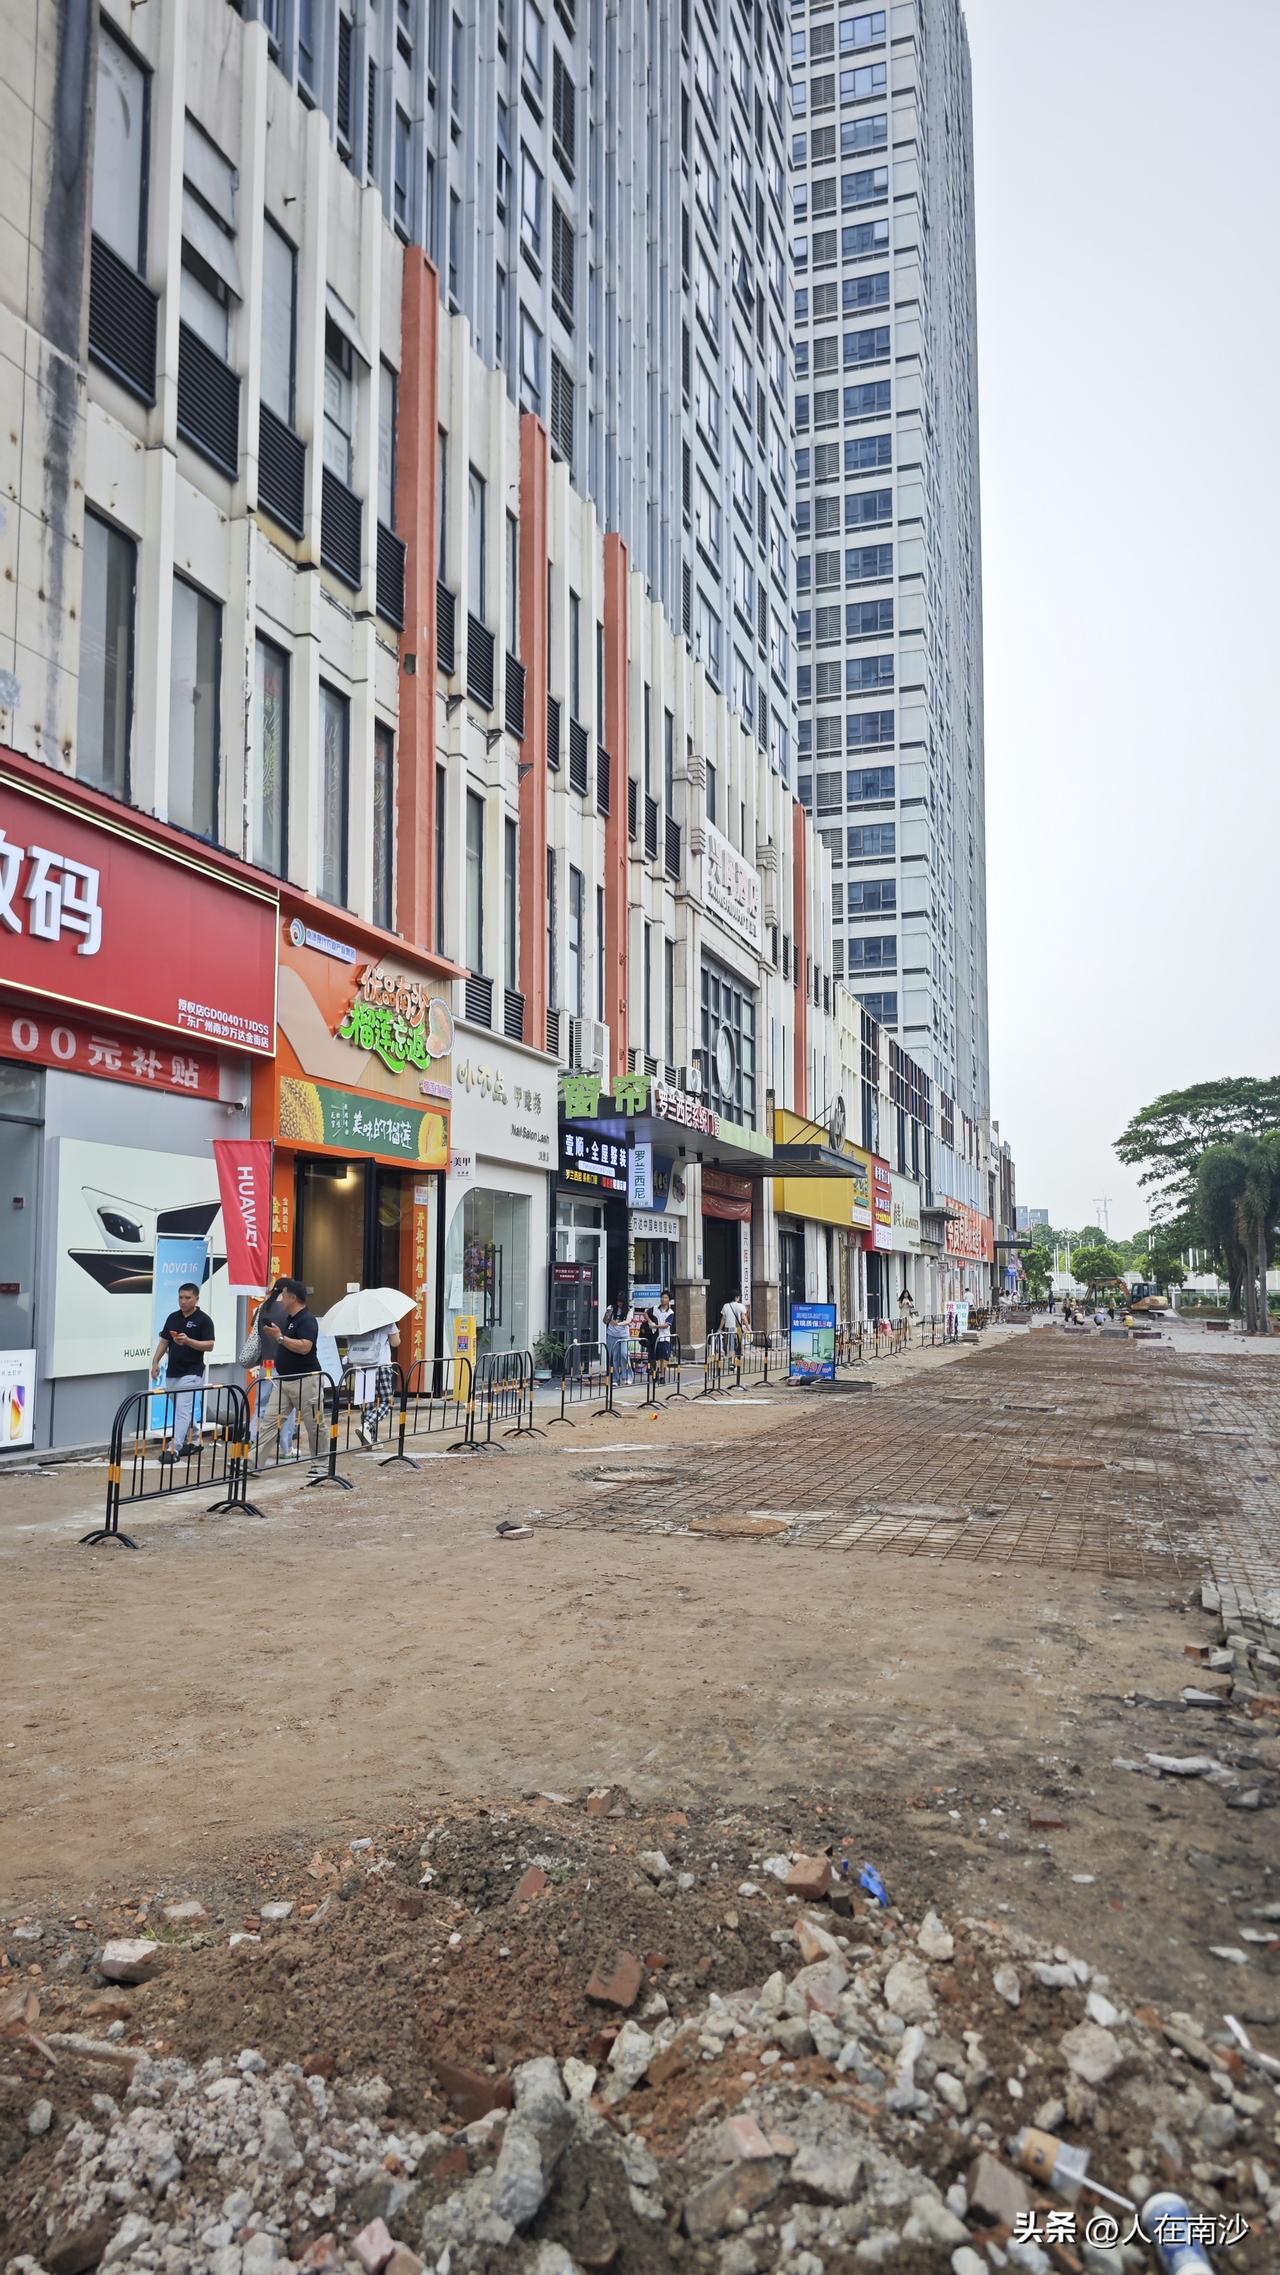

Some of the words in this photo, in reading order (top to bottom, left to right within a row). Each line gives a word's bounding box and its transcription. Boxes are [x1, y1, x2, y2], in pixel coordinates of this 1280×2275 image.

[177, 1012, 269, 1049] 广东广州南沙万达金街店
[178, 998, 269, 1036] 授权店GD004011JDSS
[340, 999, 431, 1074] 榴莲忘返
[352, 1109, 413, 1150] 美味的榴莲
[633, 1150, 646, 1200] 罗兰西尼
[237, 1166, 258, 1249] HUAWEI
[162, 1262, 187, 1273] nova
[124, 1347, 151, 1358] HUAWE
